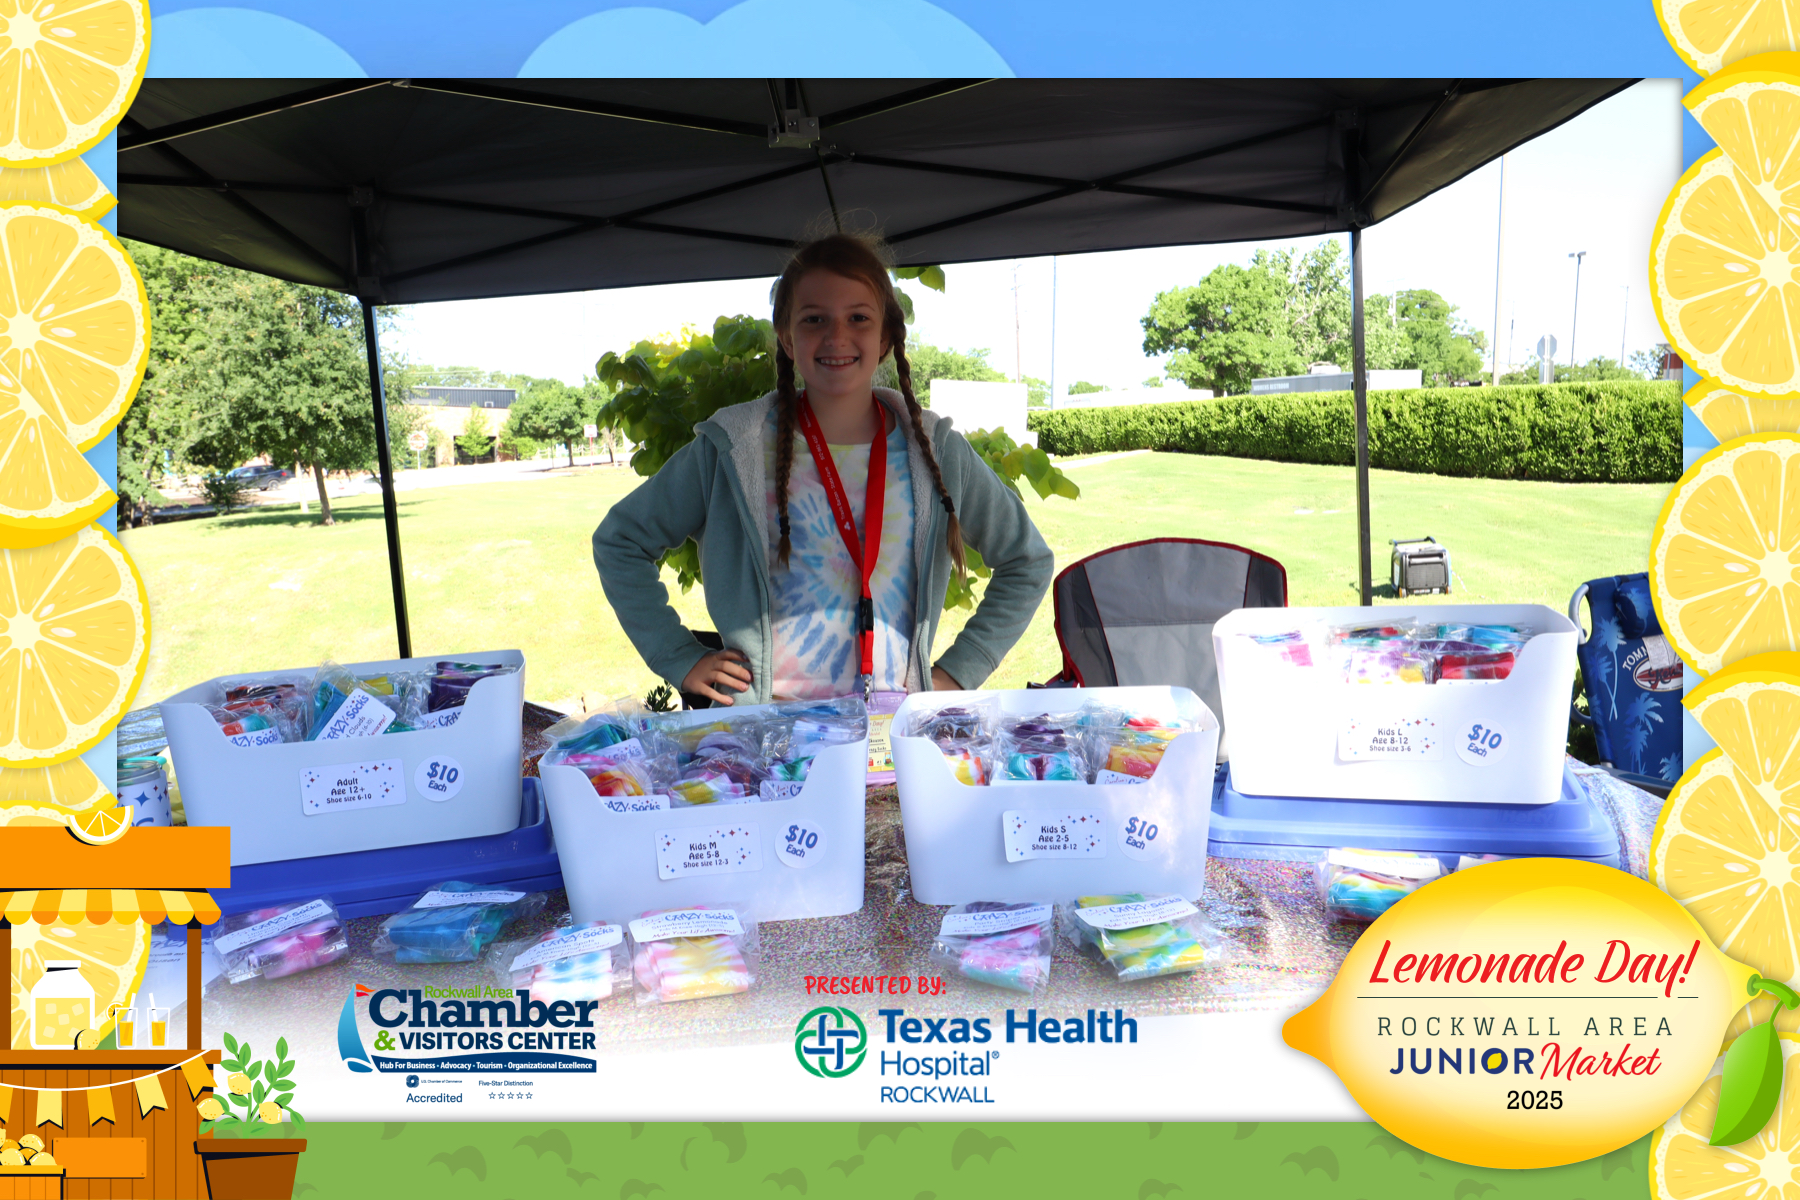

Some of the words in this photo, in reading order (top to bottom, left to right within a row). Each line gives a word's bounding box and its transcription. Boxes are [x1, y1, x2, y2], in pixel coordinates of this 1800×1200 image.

[346, 695, 370, 720] Socks
[349, 716, 366, 735] Clouds
[1377, 728, 1396, 736] Kids
[1397, 728, 1403, 736] L
[1467, 723, 1503, 750] $10
[1372, 737, 1388, 745] Age
[1390, 736, 1409, 745] 8-12
[1467, 742, 1488, 758] Each
[426, 761, 459, 784] $10
[336, 778, 359, 787] Adult
[427, 779, 448, 793] Each
[330, 788, 347, 797] Age
[349, 786, 366, 794] 12+
[326, 797, 343, 805] Shoe
[357, 793, 372, 801] 6-10
[1041, 825, 1059, 834] Kids
[1060, 825, 1067, 834] S
[1125, 816, 1159, 842] $10
[785, 824, 819, 849] $10
[1038, 835, 1054, 843] Age
[1056, 834, 1070, 843] 2-5
[689, 843, 707, 851] Kids
[709, 841, 717, 850] M
[1031, 843, 1048, 851] Shoe
[1049, 843, 1062, 851] size
[1125, 835, 1146, 851] Each
[688, 852, 705, 861] Age
[706, 850, 720, 859] 5-8
[785, 843, 806, 858] Each
[683, 861, 700, 869] Shoe
[715, 858, 729, 866] 12-3
[1109, 903, 1147, 914] CRAZY
[1150, 897, 1182, 908] Socks
[665, 912, 701, 922] CRAZY
[704, 912, 735, 920] Socks
[972, 912, 1009, 921] CRAZY
[651, 921, 691, 930] Strawberry
[541, 933, 581, 948] CRAZY
[582, 926, 614, 939] Socks
